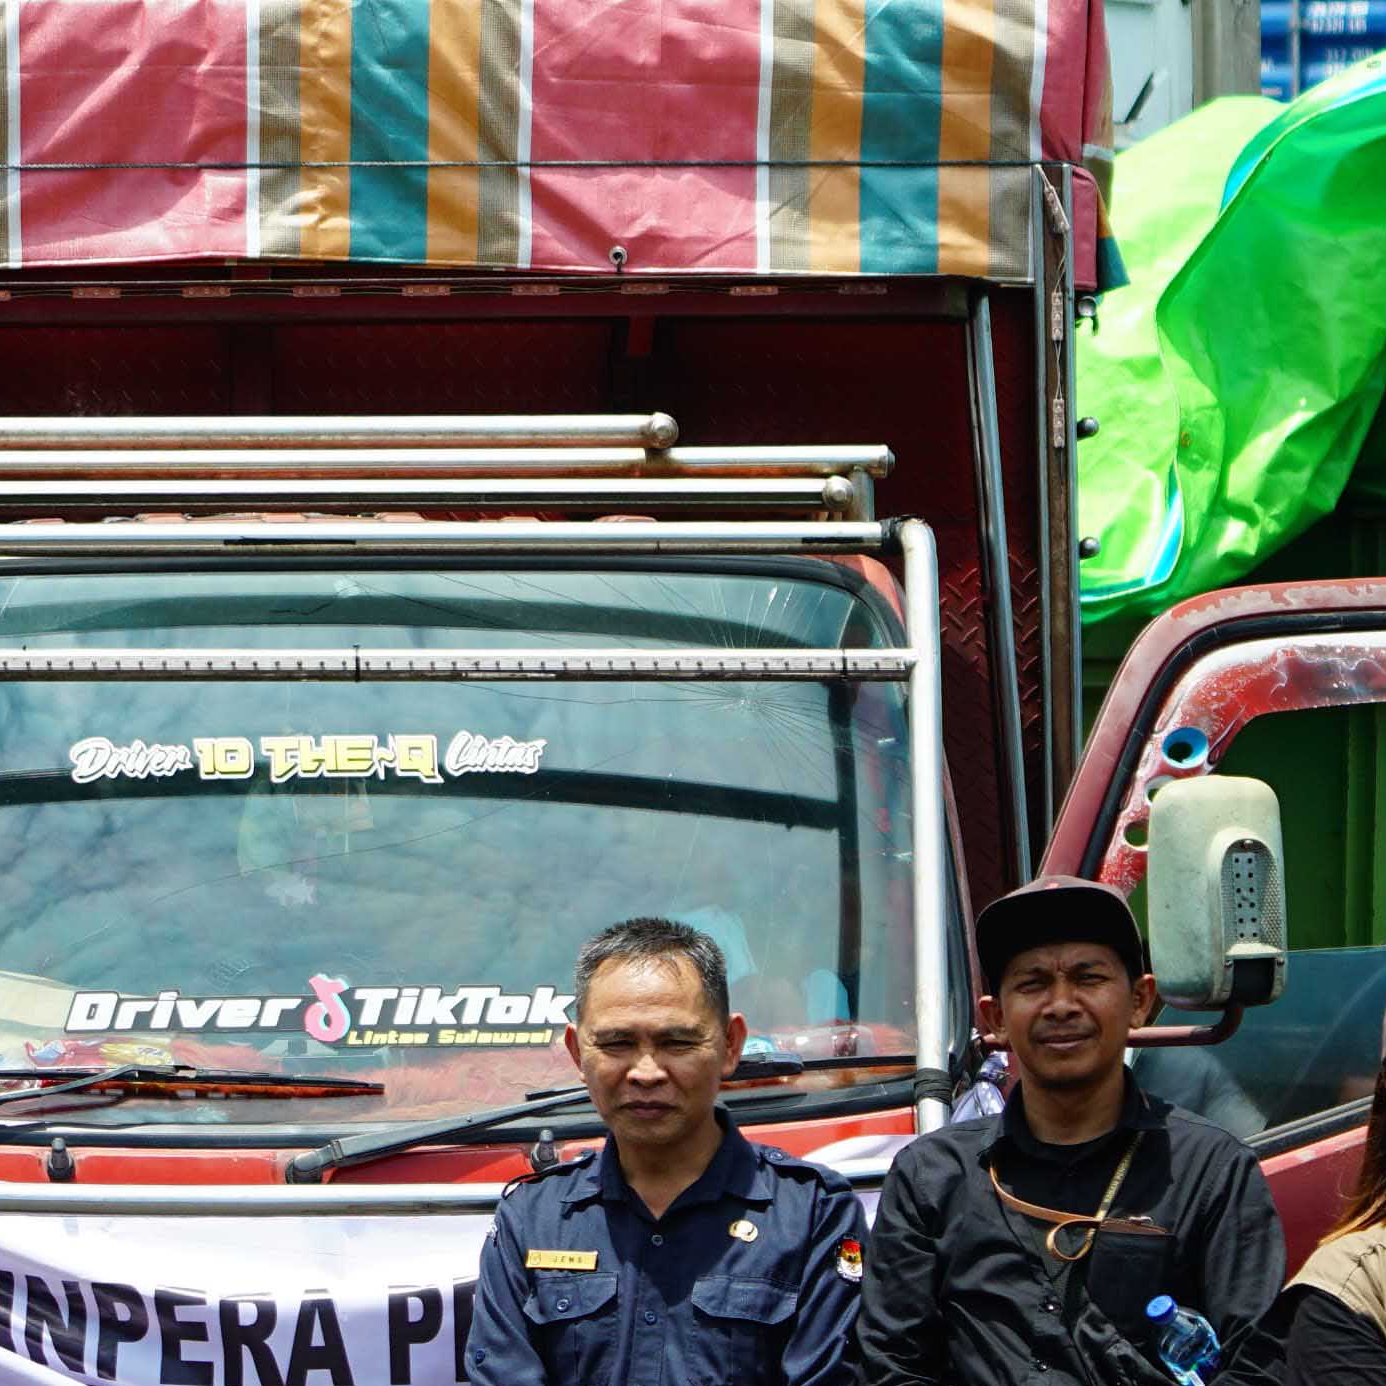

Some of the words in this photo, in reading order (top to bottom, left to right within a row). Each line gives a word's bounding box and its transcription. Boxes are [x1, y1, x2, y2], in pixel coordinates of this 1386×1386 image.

[70, 736, 193, 784] Driver
[195, 737, 254, 779] 10
[444, 730, 547, 776] Lintas
[65, 990, 303, 1033] Driver
[351, 985, 578, 1029] TikTok
